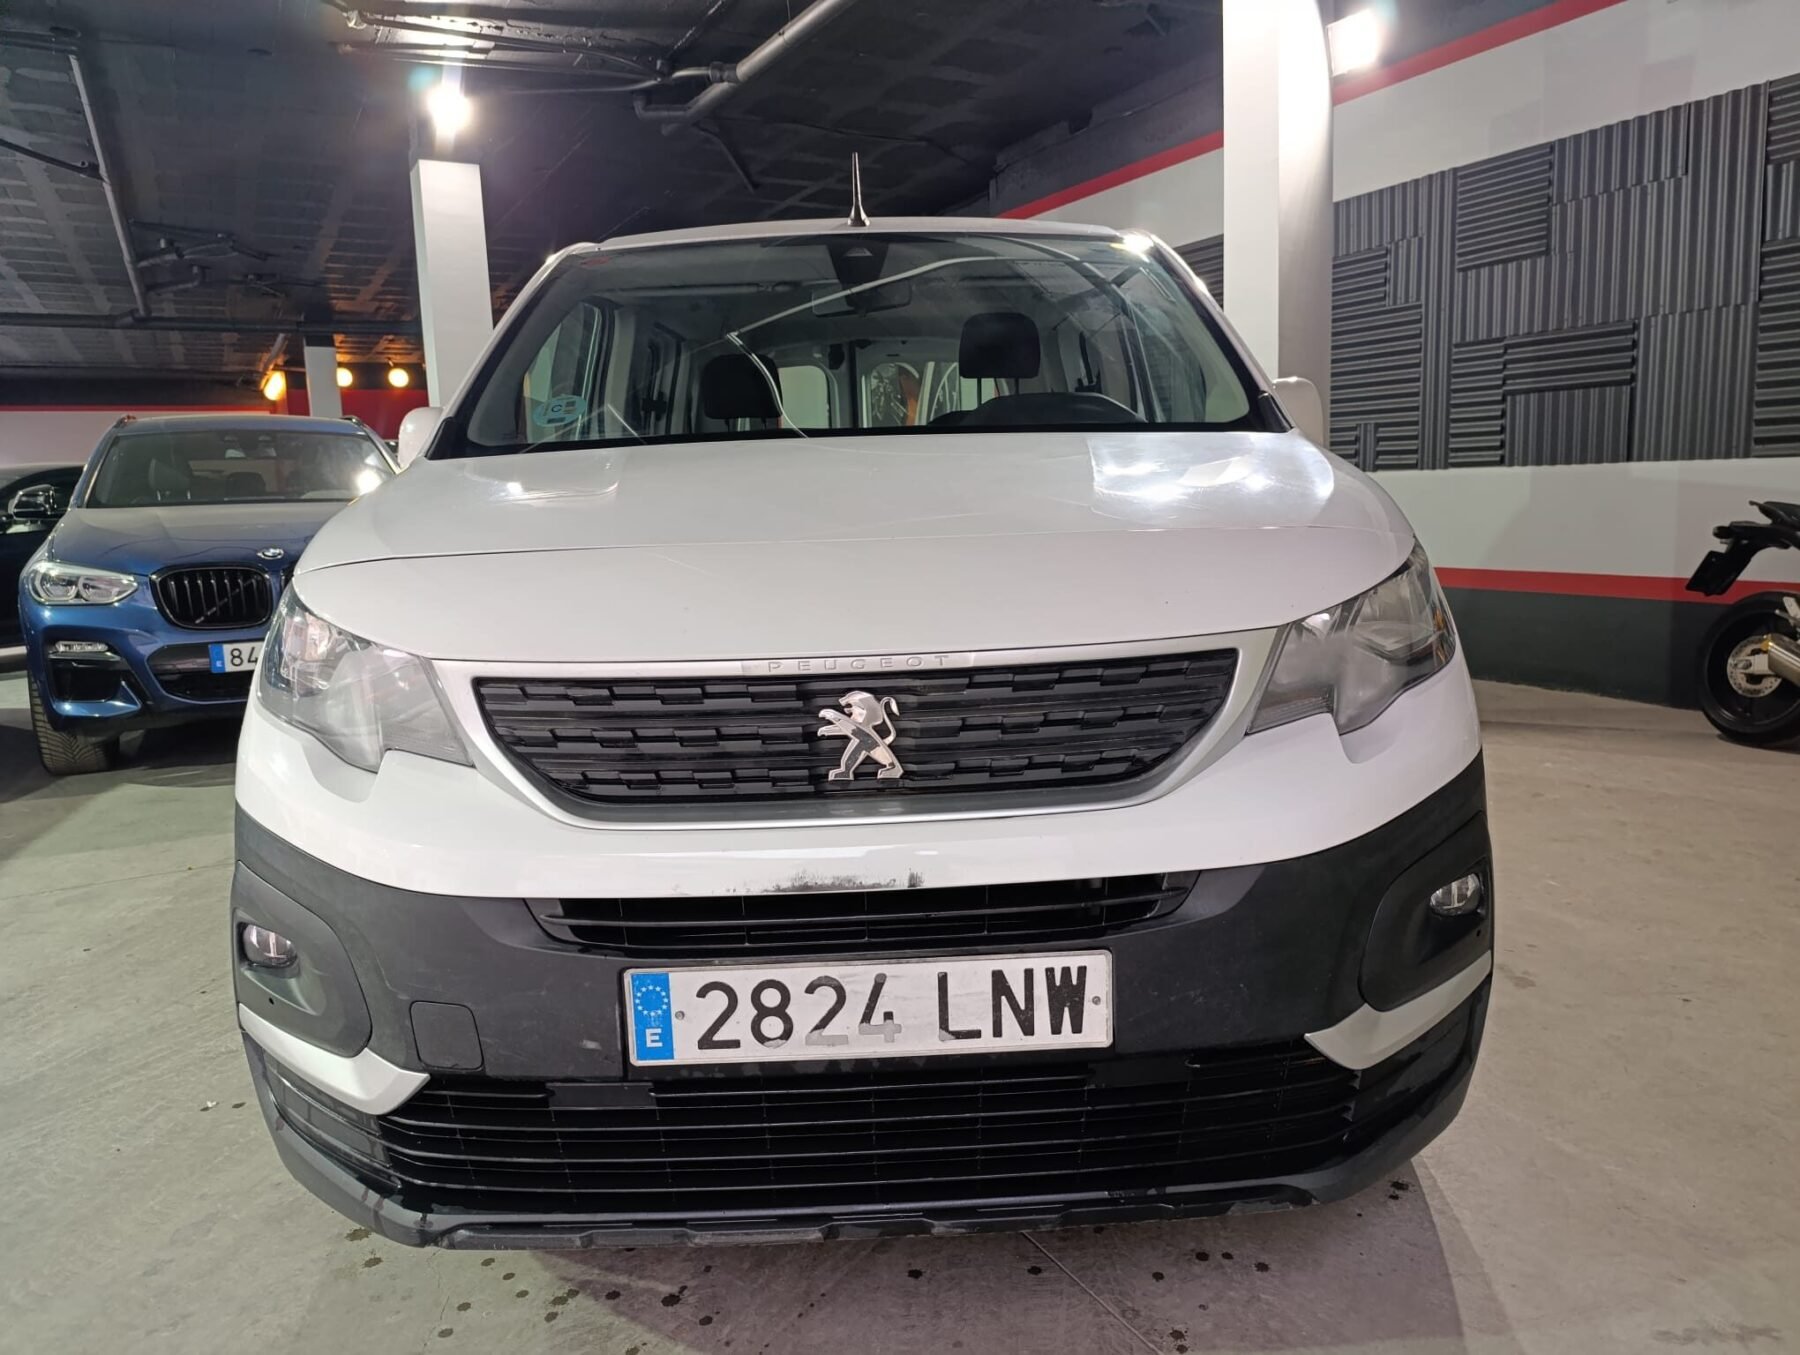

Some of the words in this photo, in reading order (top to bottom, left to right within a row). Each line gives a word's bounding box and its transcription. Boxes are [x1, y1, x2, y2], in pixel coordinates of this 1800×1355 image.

[767, 655, 950, 673] PEUGEOT
[695, 973, 903, 1050] 2824
[936, 965, 1088, 1042] LNW
[645, 1028, 663, 1047] E
